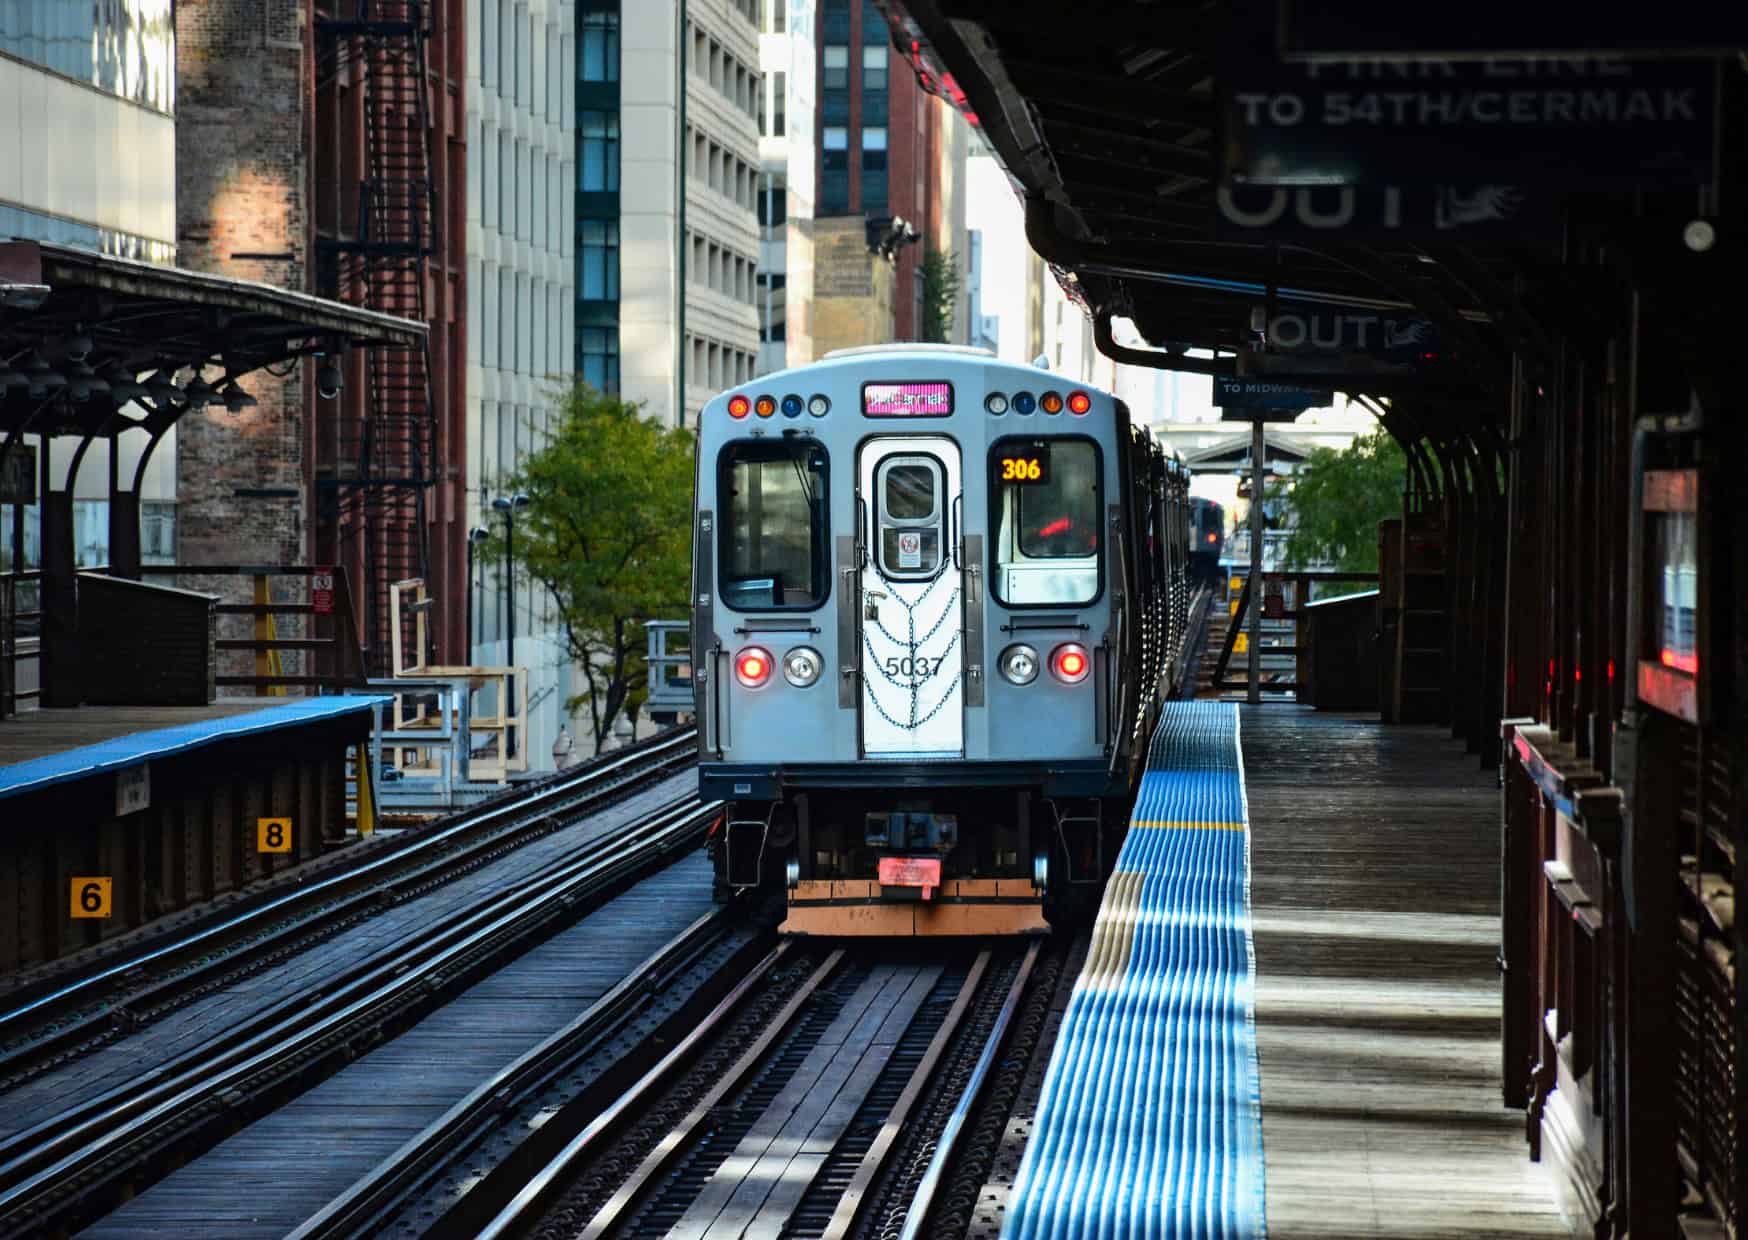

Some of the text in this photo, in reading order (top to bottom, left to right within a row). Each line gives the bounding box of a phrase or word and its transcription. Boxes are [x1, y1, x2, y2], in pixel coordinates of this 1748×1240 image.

[1234, 89, 1697, 127] TO 54TH/CERMAK
[1268, 314, 1378, 349] OUT
[1223, 384, 1241, 393] TO
[1002, 458, 1041, 480] 306
[886, 657, 942, 676] 5037
[265, 823, 284, 848] 8
[80, 882, 102, 912] 6
